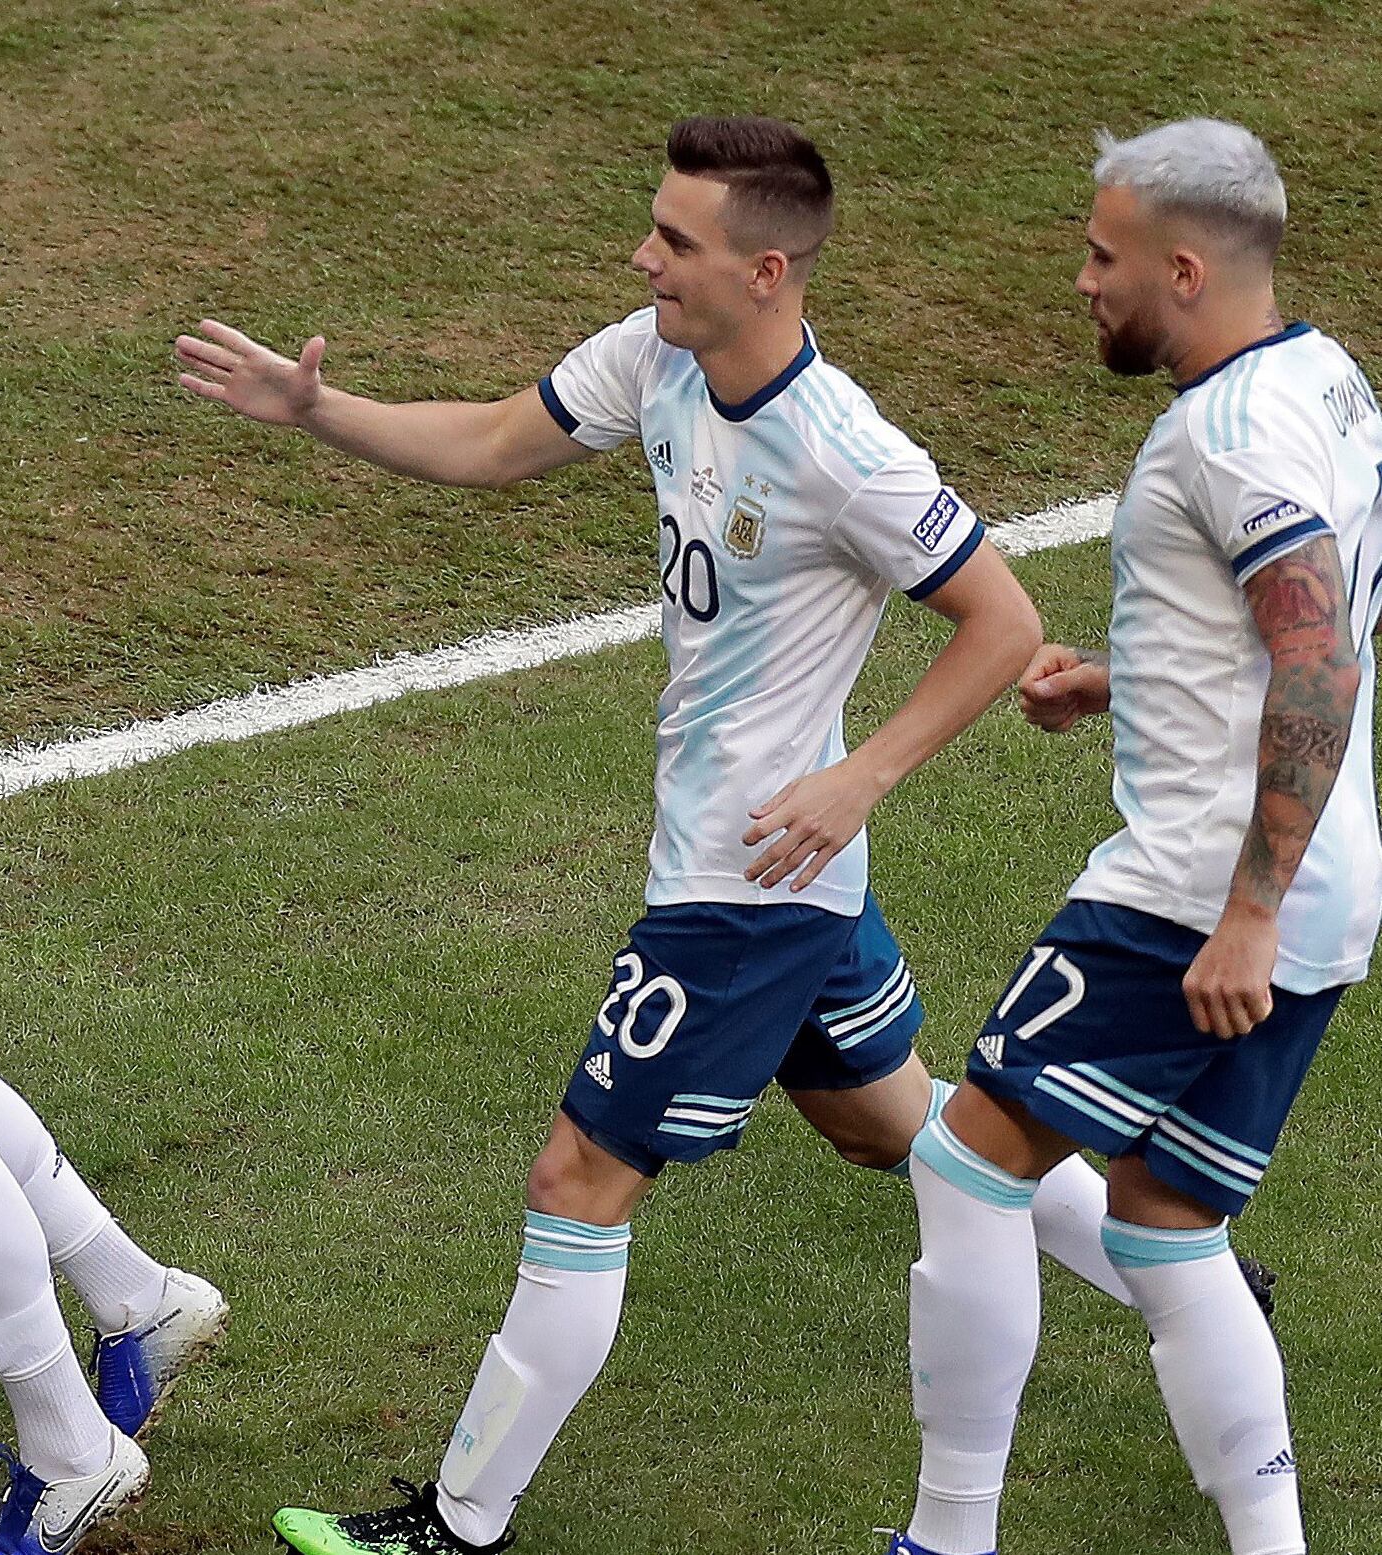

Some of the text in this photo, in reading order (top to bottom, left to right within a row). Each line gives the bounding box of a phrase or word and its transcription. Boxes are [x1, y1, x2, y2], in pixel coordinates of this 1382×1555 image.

[916, 493, 949, 538] Cree en
[925, 503, 955, 549] grande
[659, 514, 720, 623] 20
[595, 951, 688, 1060] 20
[996, 945, 1086, 1041] 17
[584, 1059, 614, 1090] adidas
